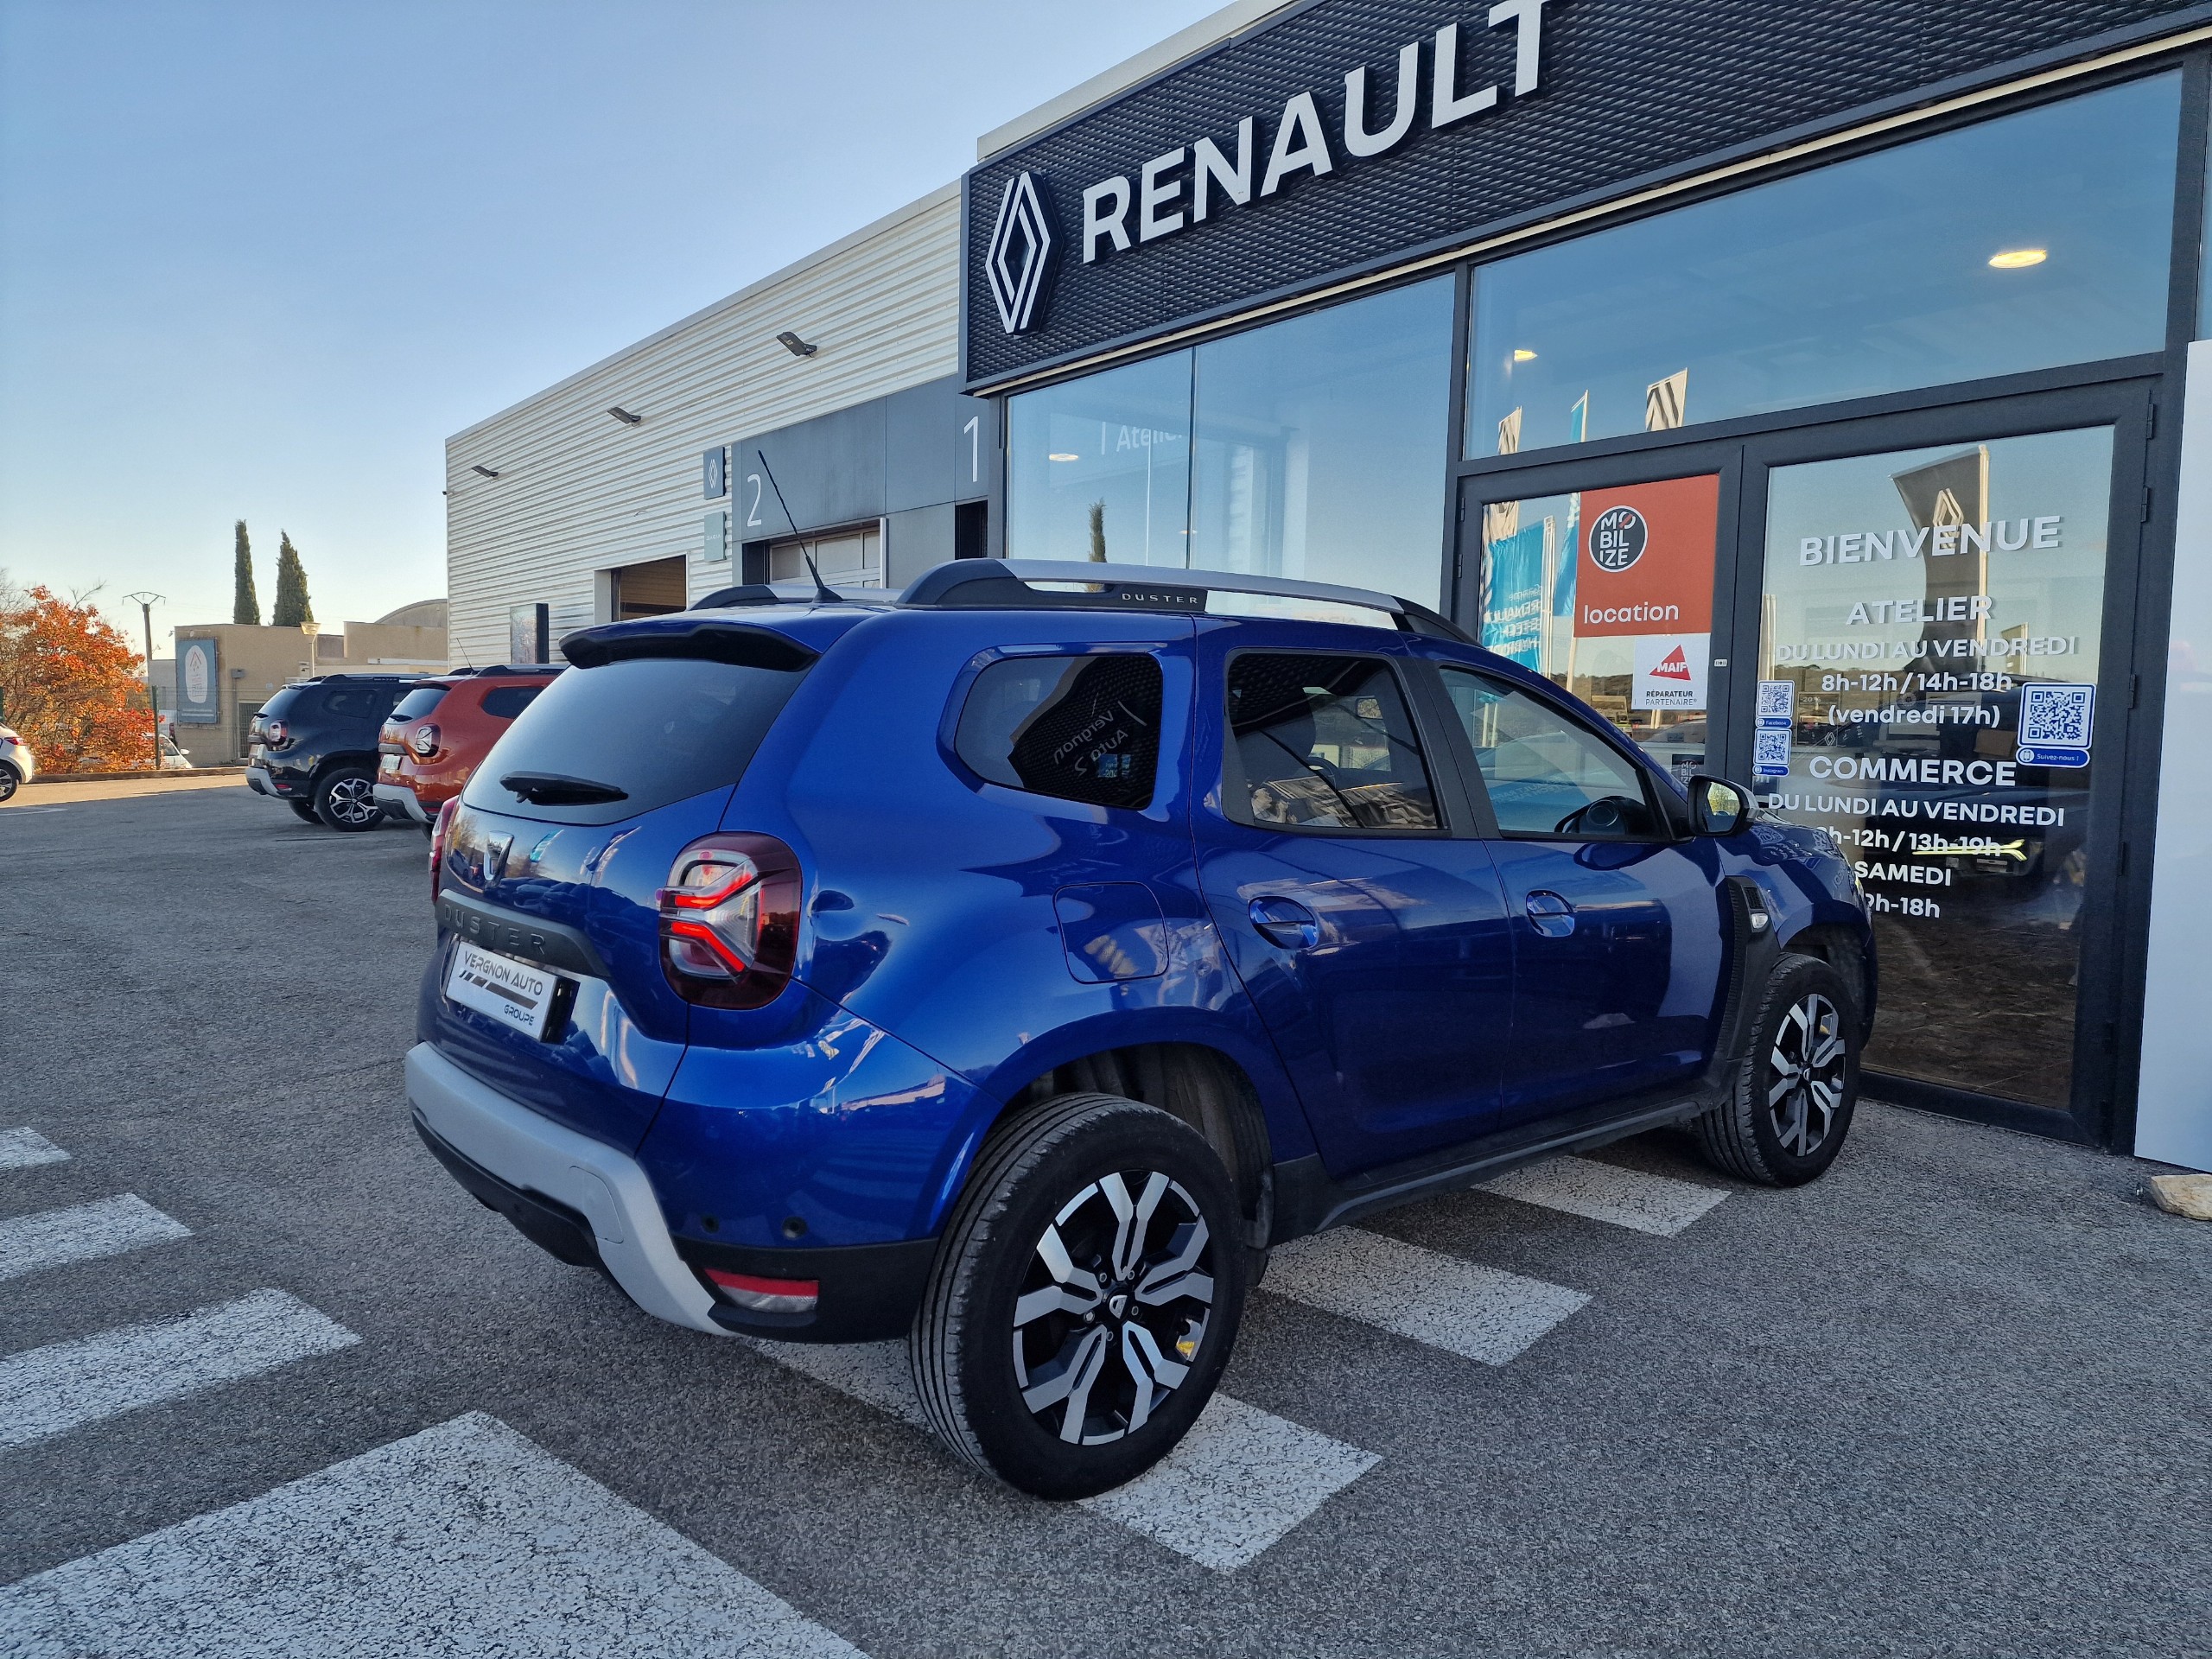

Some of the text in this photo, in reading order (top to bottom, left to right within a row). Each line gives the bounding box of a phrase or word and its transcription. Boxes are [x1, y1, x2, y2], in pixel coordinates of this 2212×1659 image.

[1083, 0, 1551, 264] RENAULT
[963, 416, 979, 483] 1
[747, 474, 762, 528] 2
[1599, 531, 1630, 549] BIL
[1800, 516, 2062, 566] BIENVENUE
[1599, 549, 1630, 566] IZE
[1122, 593, 1198, 604] DUSTER
[1846, 595, 1993, 625] ATELIER
[1584, 601, 1680, 624] location
[1776, 636, 2075, 660] DU LUNDI AU VENDREDI
[1656, 661, 1687, 673] MAIF
[1821, 673, 1897, 692] 8h-12h
[1917, 671, 2012, 692] 14h-18h
[1828, 705, 2000, 728] (vendredi 17h)
[1808, 756, 2018, 786] COMMERCE
[1768, 793, 2066, 827] DU LUNDI AU VENDREDI
[1909, 832, 2001, 857] 13h-19h
[1854, 861, 1951, 887] SAMEDI
[444, 904, 546, 955] DUSTER
[464, 950, 543, 996] VERGNON AUTO
[504, 1004, 535, 1027] GROUPE
